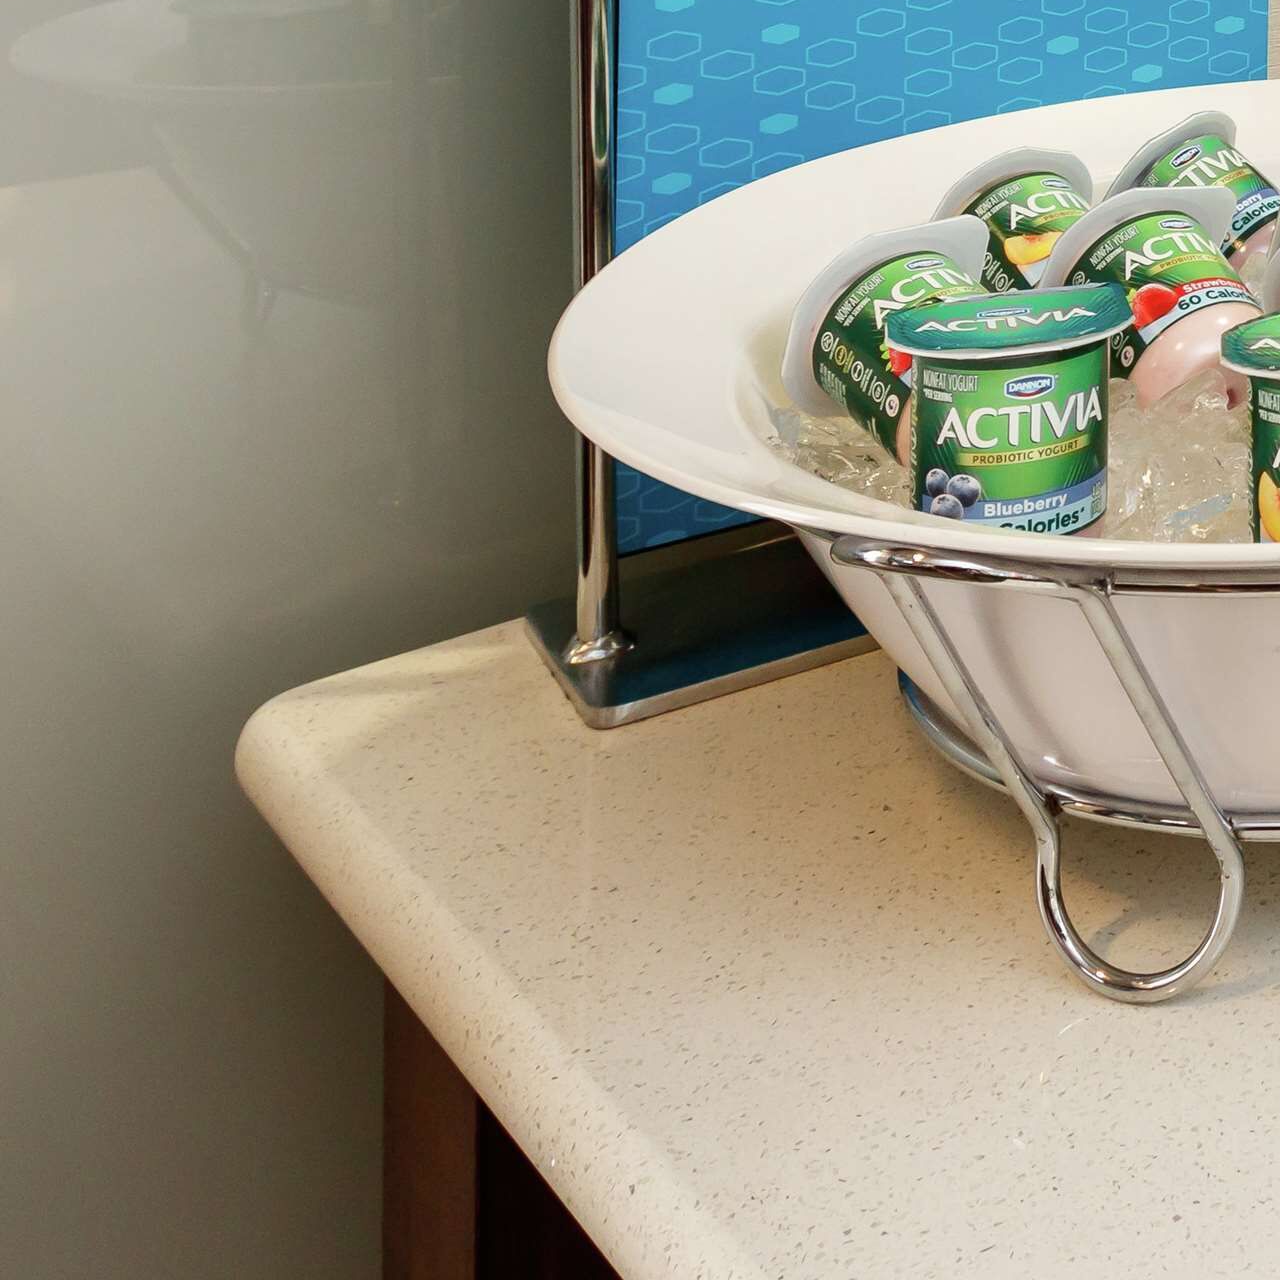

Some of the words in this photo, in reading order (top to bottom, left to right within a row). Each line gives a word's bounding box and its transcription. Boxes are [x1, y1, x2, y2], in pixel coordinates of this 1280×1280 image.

[1178, 294, 1201, 311] 60
[914, 307, 1099, 333] ACTIVIA
[923, 370, 946, 389] NONFAT
[946, 374, 979, 393] YOGURT
[1008, 378, 1052, 394] DANNON
[1258, 390, 1280, 411] NONFAT
[937, 386, 1103, 450] ACTIVIA
[972, 449, 1035, 465] PROBIOTIC
[1037, 438, 1081, 458] YOGURT
[983, 493, 1068, 518] Blueberry
